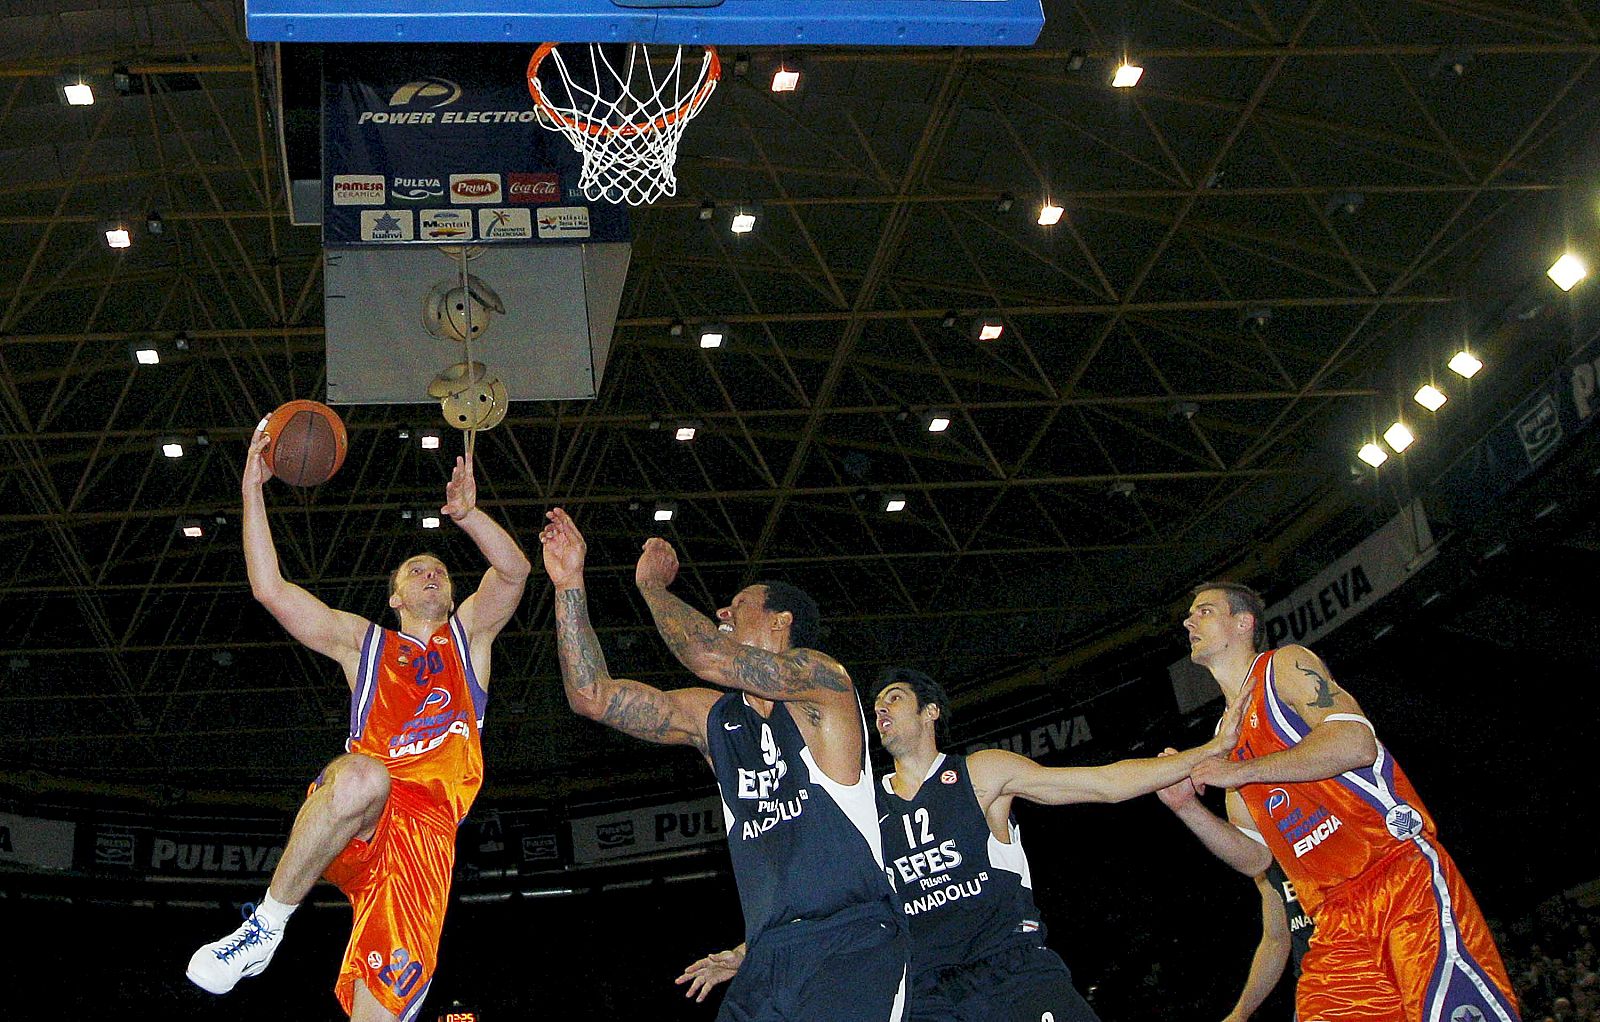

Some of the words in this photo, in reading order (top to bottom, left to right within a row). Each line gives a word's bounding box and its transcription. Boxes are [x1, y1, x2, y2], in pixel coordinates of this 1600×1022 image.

[358, 112, 435, 124] POWER
[335, 182, 383, 190] PAMESA
[394, 178, 441, 187] PULEVA
[1266, 565, 1372, 650] PULEVA
[413, 651, 444, 686] 20
[761, 723, 777, 765] 9
[966, 714, 1093, 758] LEVA
[902, 808, 935, 850] 12
[1293, 815, 1342, 859] ENCIA
[151, 838, 285, 872] PULEVA
[893, 839, 963, 885] EFES
[904, 878, 982, 916] ANADOLU
[378, 947, 423, 997] 20
